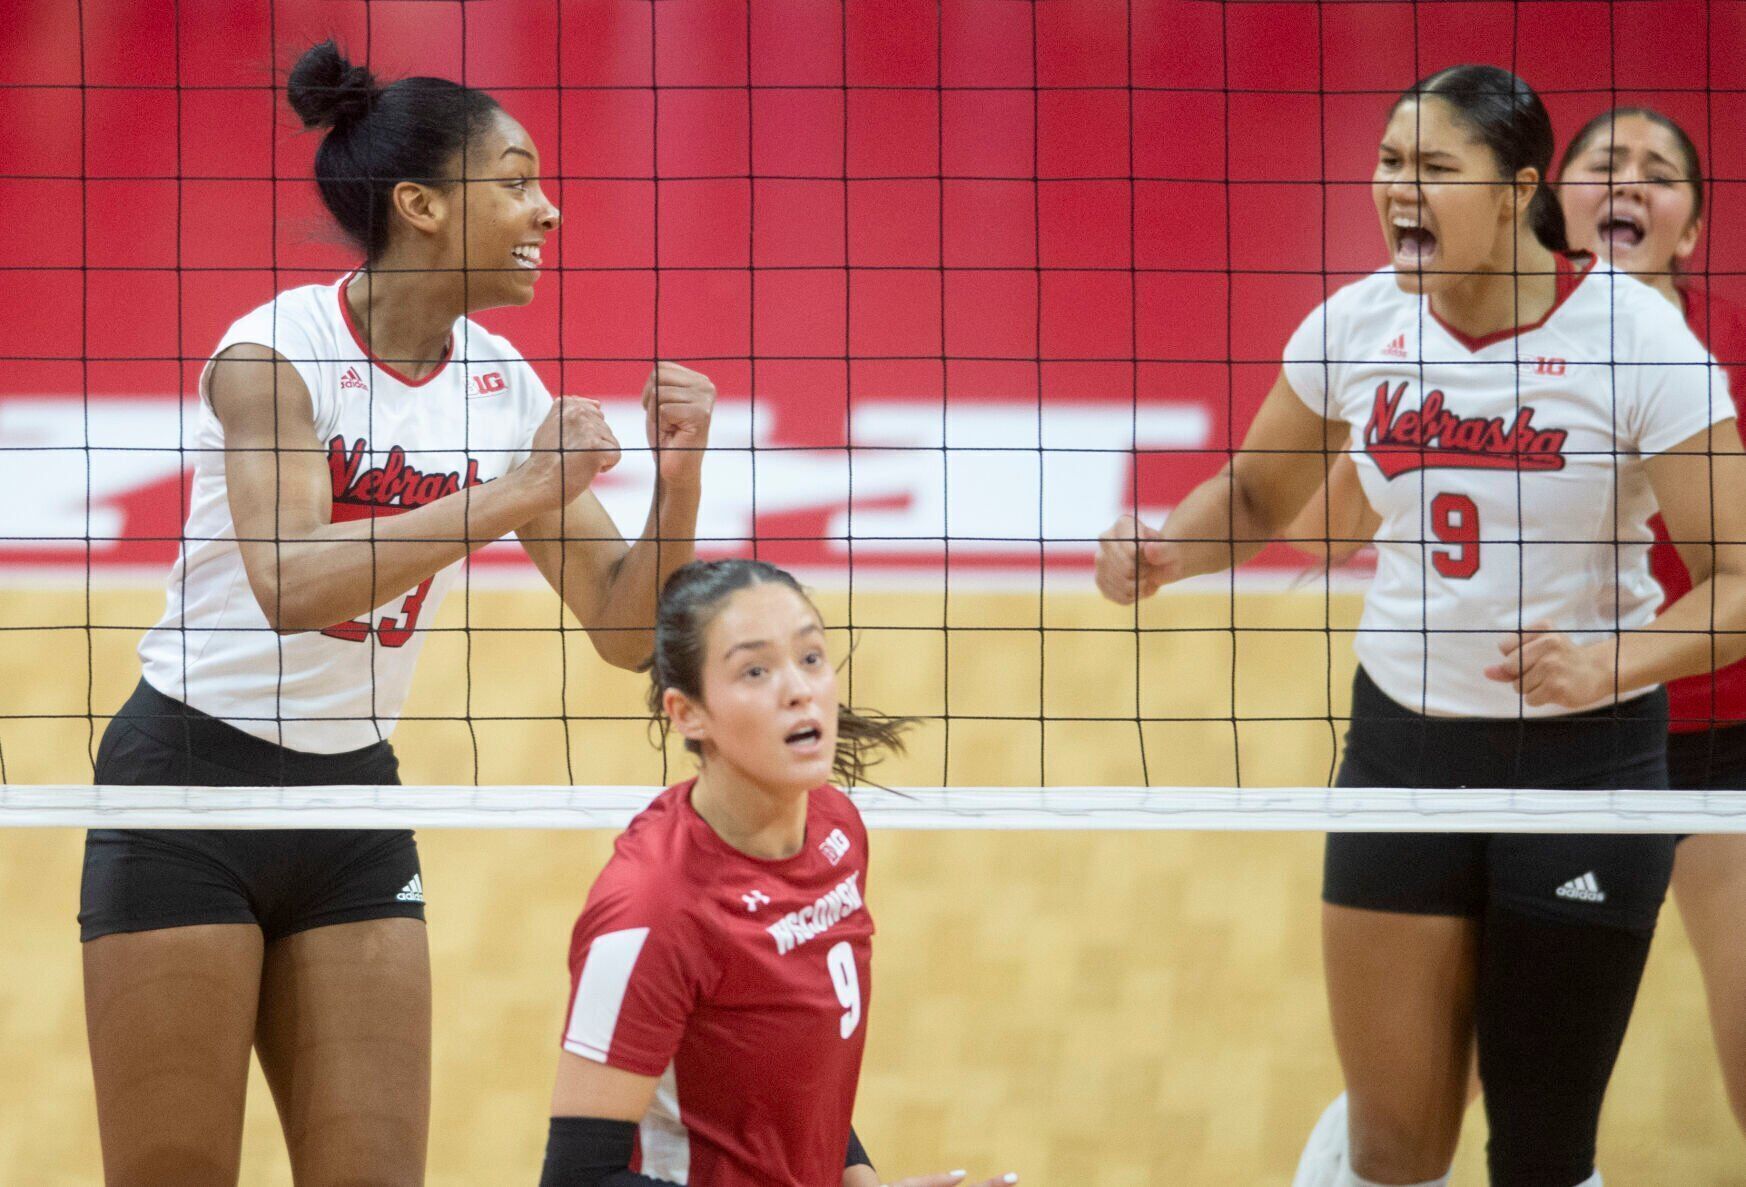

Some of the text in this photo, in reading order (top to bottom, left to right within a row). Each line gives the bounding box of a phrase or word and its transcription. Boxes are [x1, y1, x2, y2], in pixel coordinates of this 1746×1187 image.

[1364, 381, 1568, 459] Nebraska
[327, 434, 498, 511] Nebras
[1431, 492, 1481, 580] 9
[1555, 886, 1605, 902] adidas
[827, 941, 861, 1040] 9
